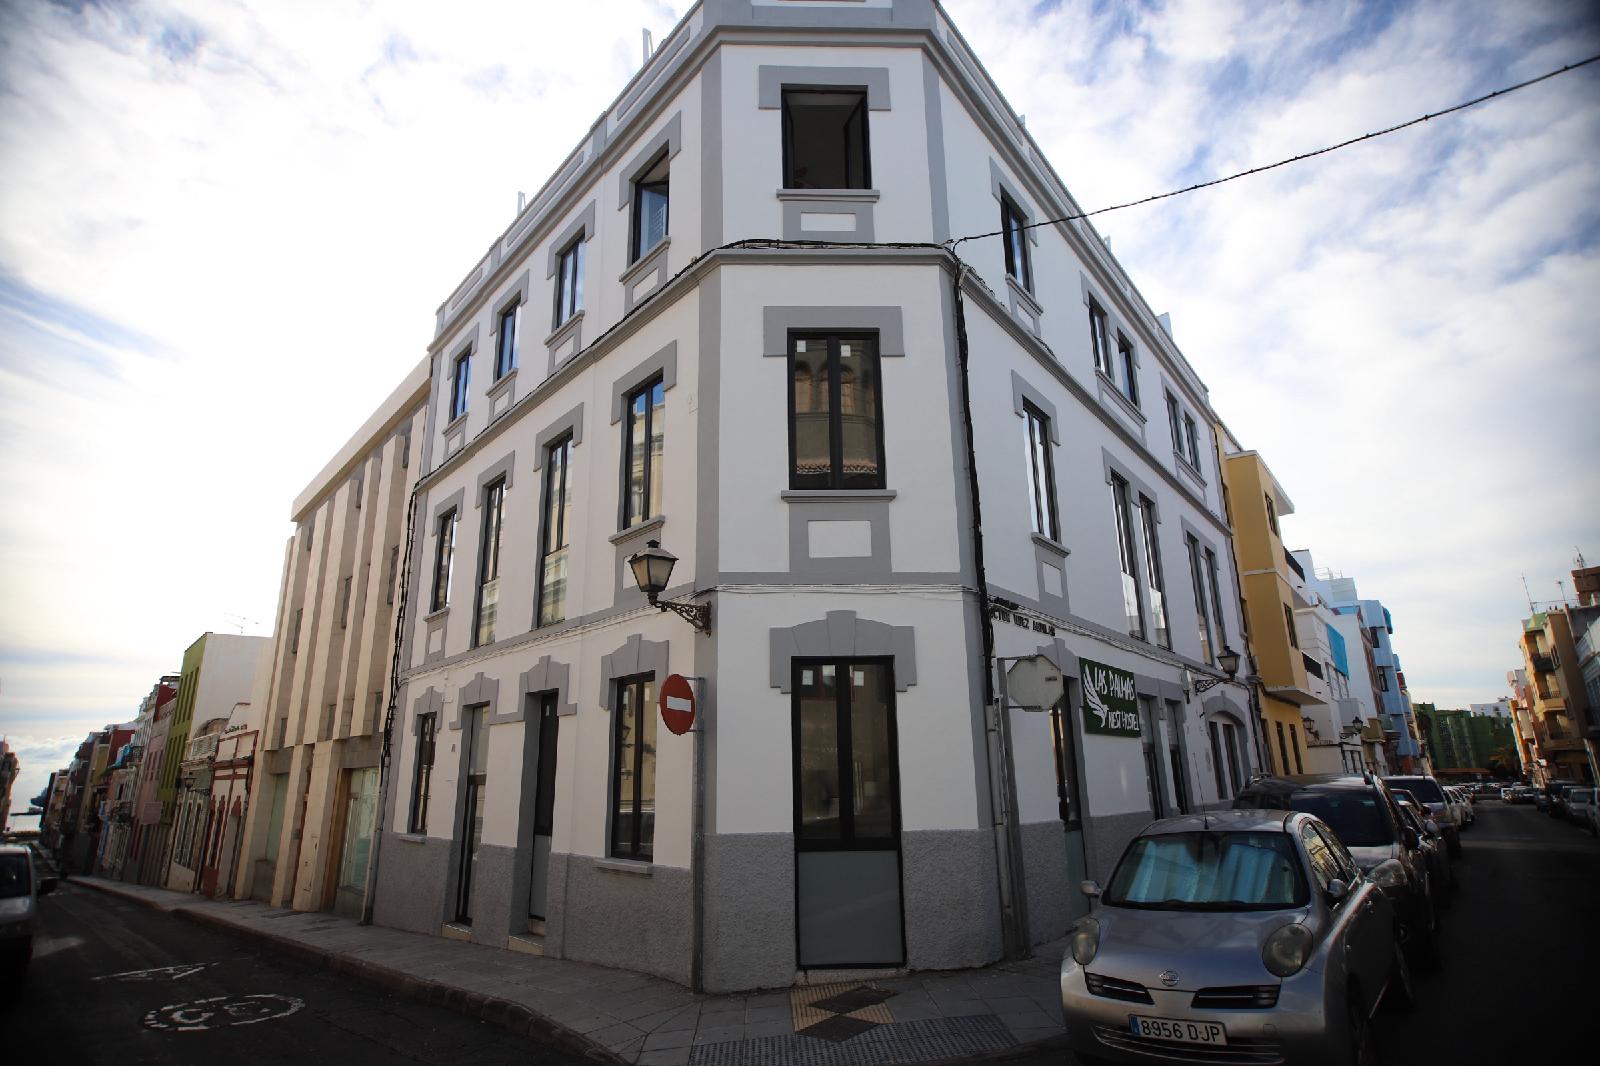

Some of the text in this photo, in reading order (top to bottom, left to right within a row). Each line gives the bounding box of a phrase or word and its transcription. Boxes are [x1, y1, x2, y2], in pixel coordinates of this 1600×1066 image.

[1094, 666, 1135, 701] LAS PALMAS
[1108, 710, 1140, 731] NEST HOSTEL
[1141, 1020, 1220, 1042] 8956 DJP
